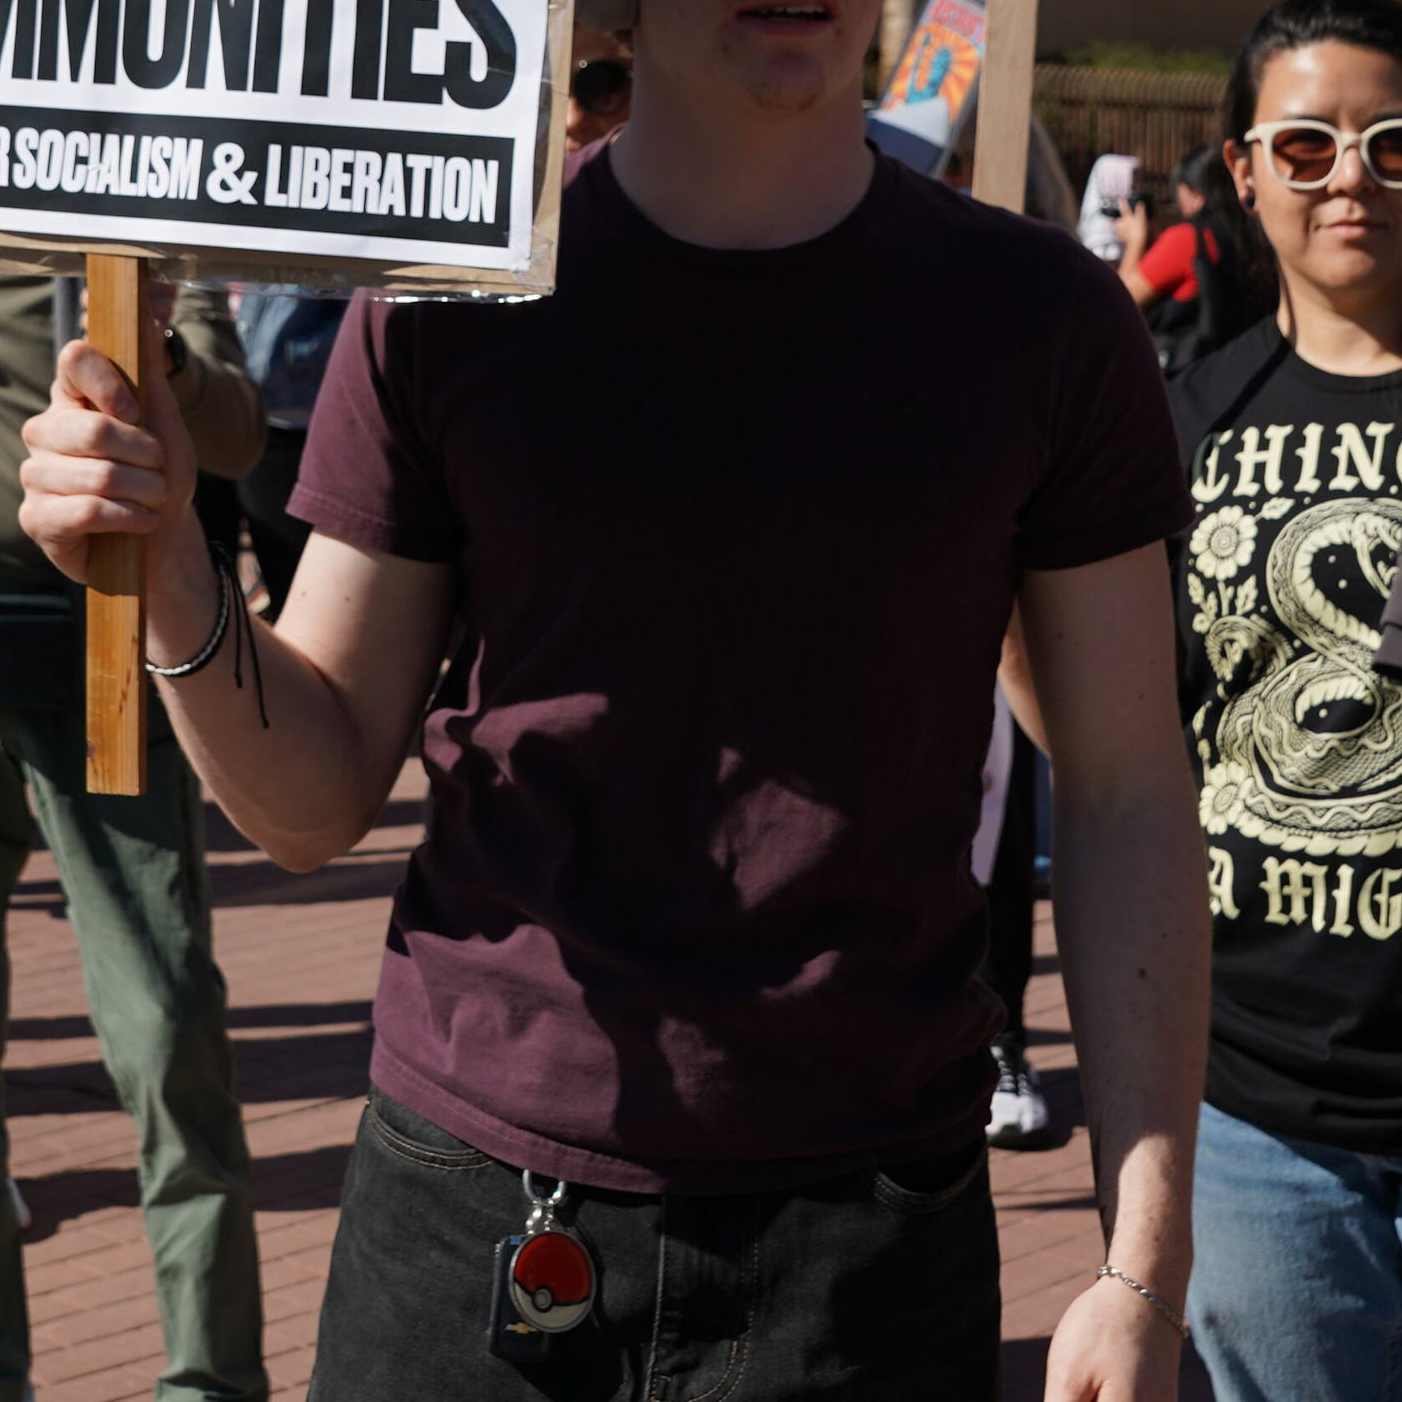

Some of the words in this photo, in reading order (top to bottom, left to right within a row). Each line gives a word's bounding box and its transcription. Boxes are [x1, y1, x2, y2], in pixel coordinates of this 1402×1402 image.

[15, 127, 205, 201] SOCIALISM
[206, 143, 258, 205] &
[265, 144, 498, 225] LIBERATION
